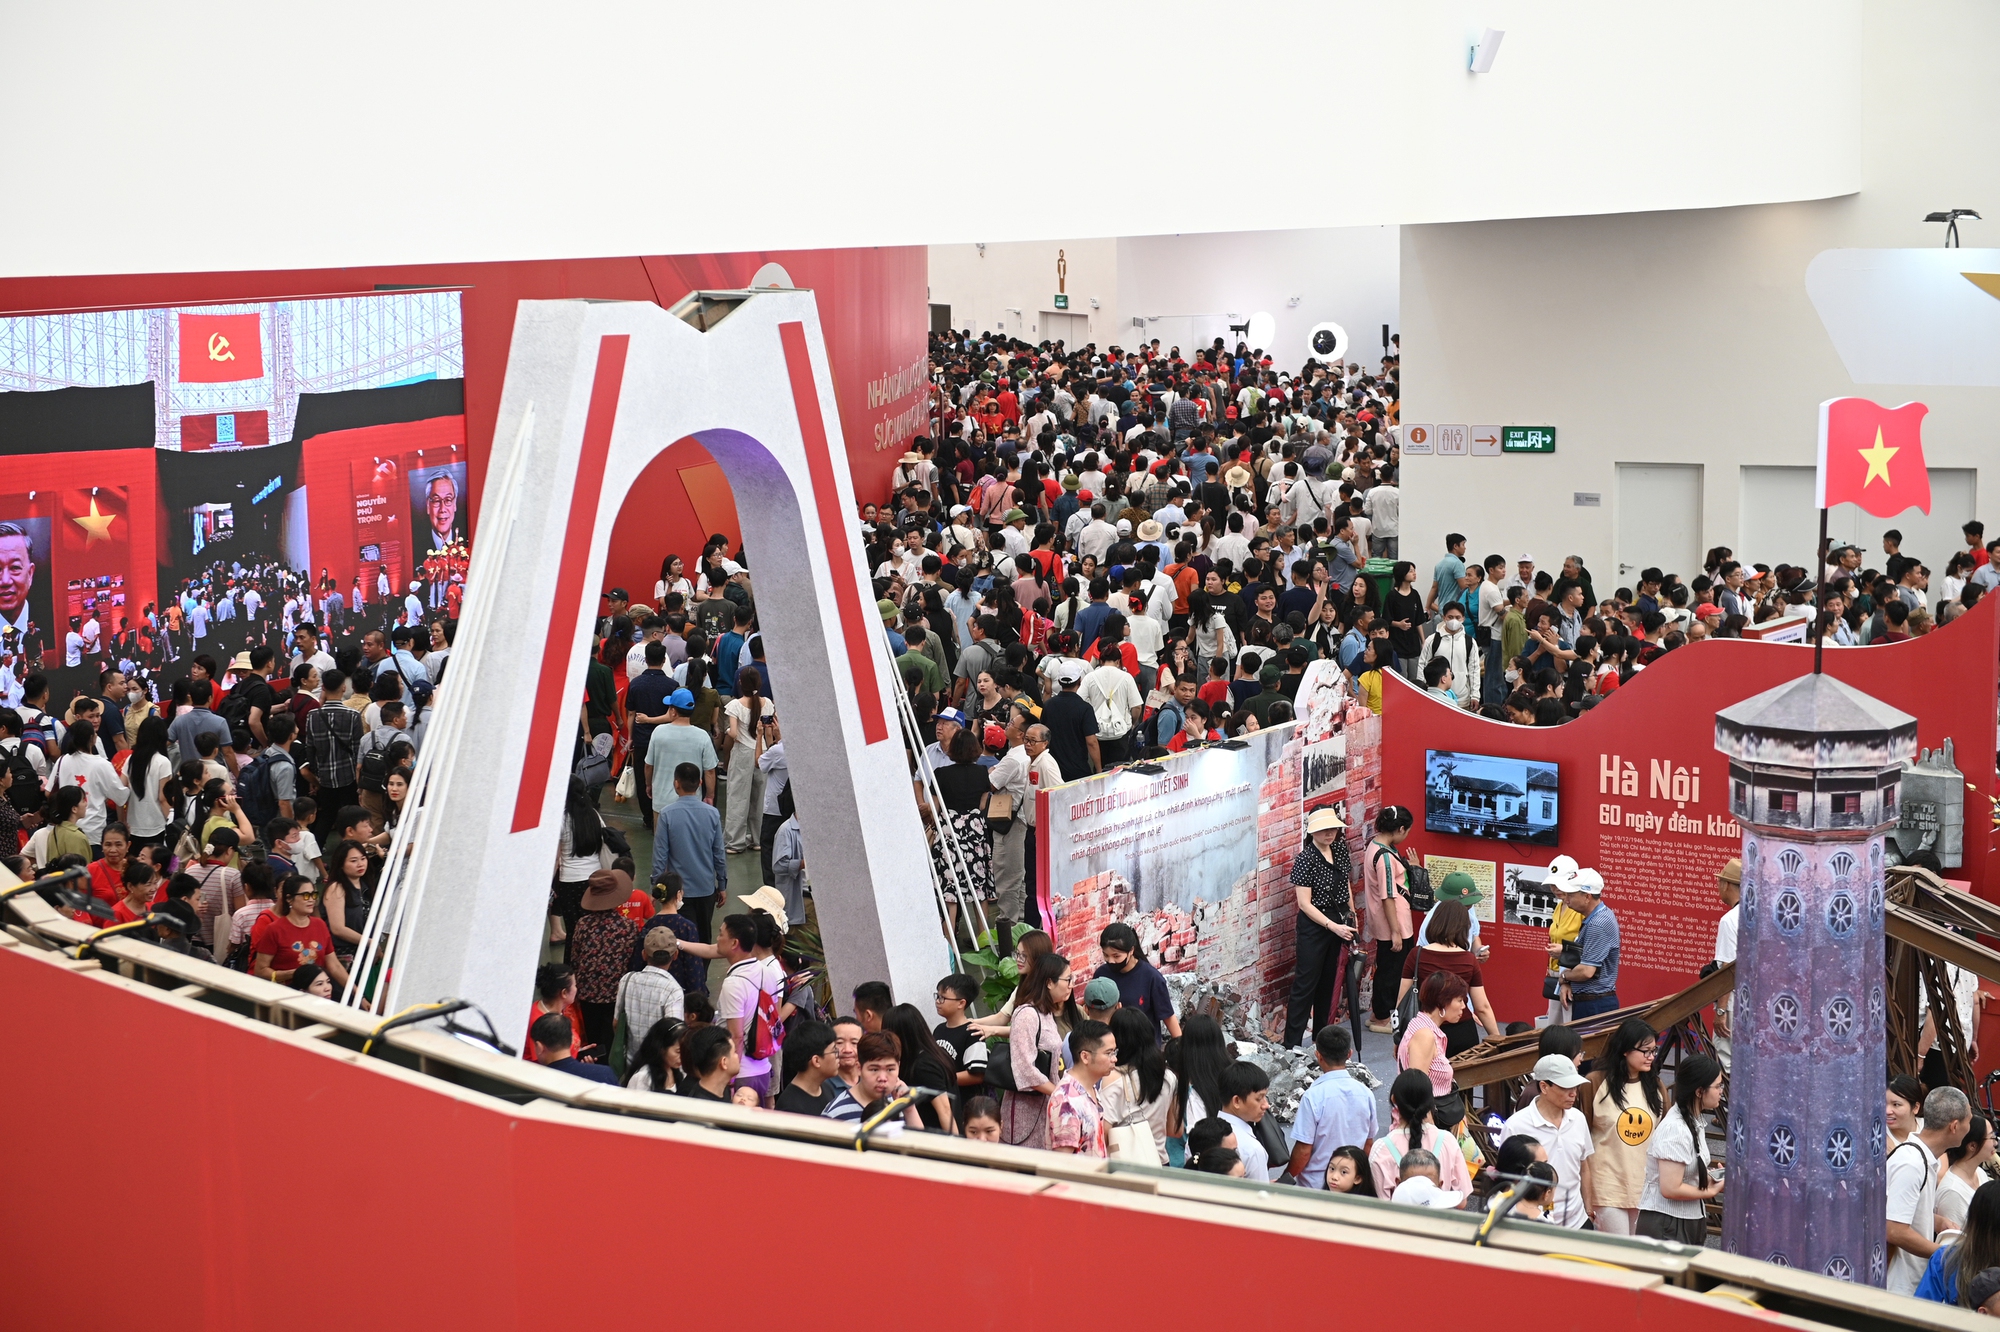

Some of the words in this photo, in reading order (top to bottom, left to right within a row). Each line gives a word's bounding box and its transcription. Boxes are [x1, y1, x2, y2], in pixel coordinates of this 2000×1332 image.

[874, 413, 894, 452] SỨC
[1600, 754, 1639, 797] Hà
[1650, 758, 1700, 809] Nội
[1071, 794, 1094, 821] QUYẾT
[1150, 774, 1171, 798] QUYẾT
[1173, 773, 1189, 791] SINH
[1599, 804, 1620, 826] 60
[1625, 811, 1663, 834] ngày
[1668, 811, 1702, 834] đêm
[1614, 835, 1644, 844] 19/12/1946,
[1600, 863, 1612, 871] Công
[1665, 863, 1694, 872] 19/12/1946
[1626, 888, 1640, 896] trong
[1654, 935, 1667, 943] trong
[1624, 1129, 1644, 1139] drew
